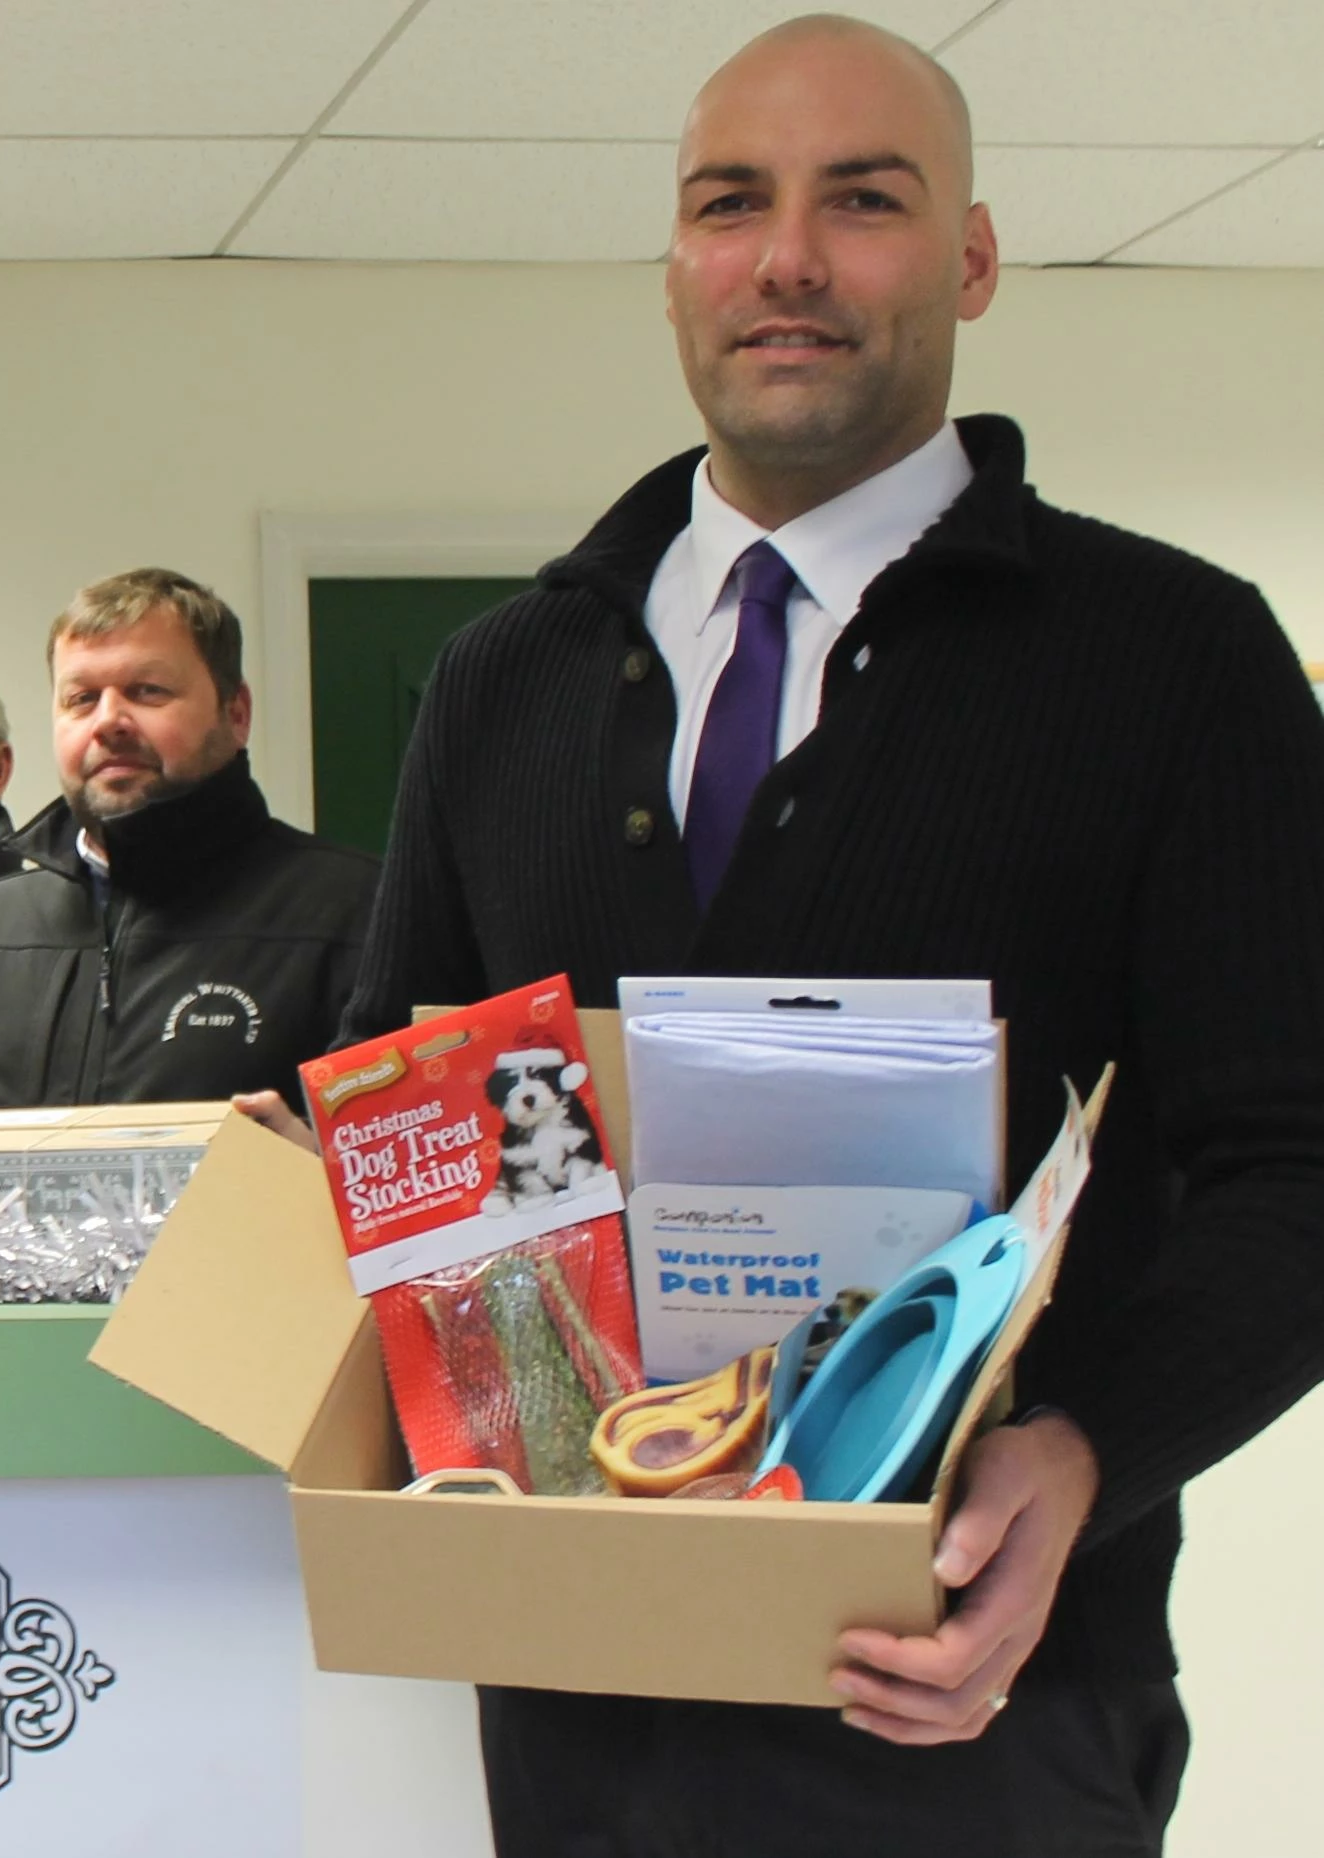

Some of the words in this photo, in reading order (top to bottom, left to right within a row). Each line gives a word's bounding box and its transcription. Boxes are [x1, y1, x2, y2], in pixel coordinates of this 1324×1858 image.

[333, 1100, 444, 1151] Christmas
[339, 1141, 398, 1188] Dog
[398, 1111, 483, 1165] Treat
[346, 1149, 482, 1222] Stocking
[658, 1248, 821, 1269] Waterproof
[660, 1271, 730, 1297] Pet
[744, 1273, 822, 1299] Mat
